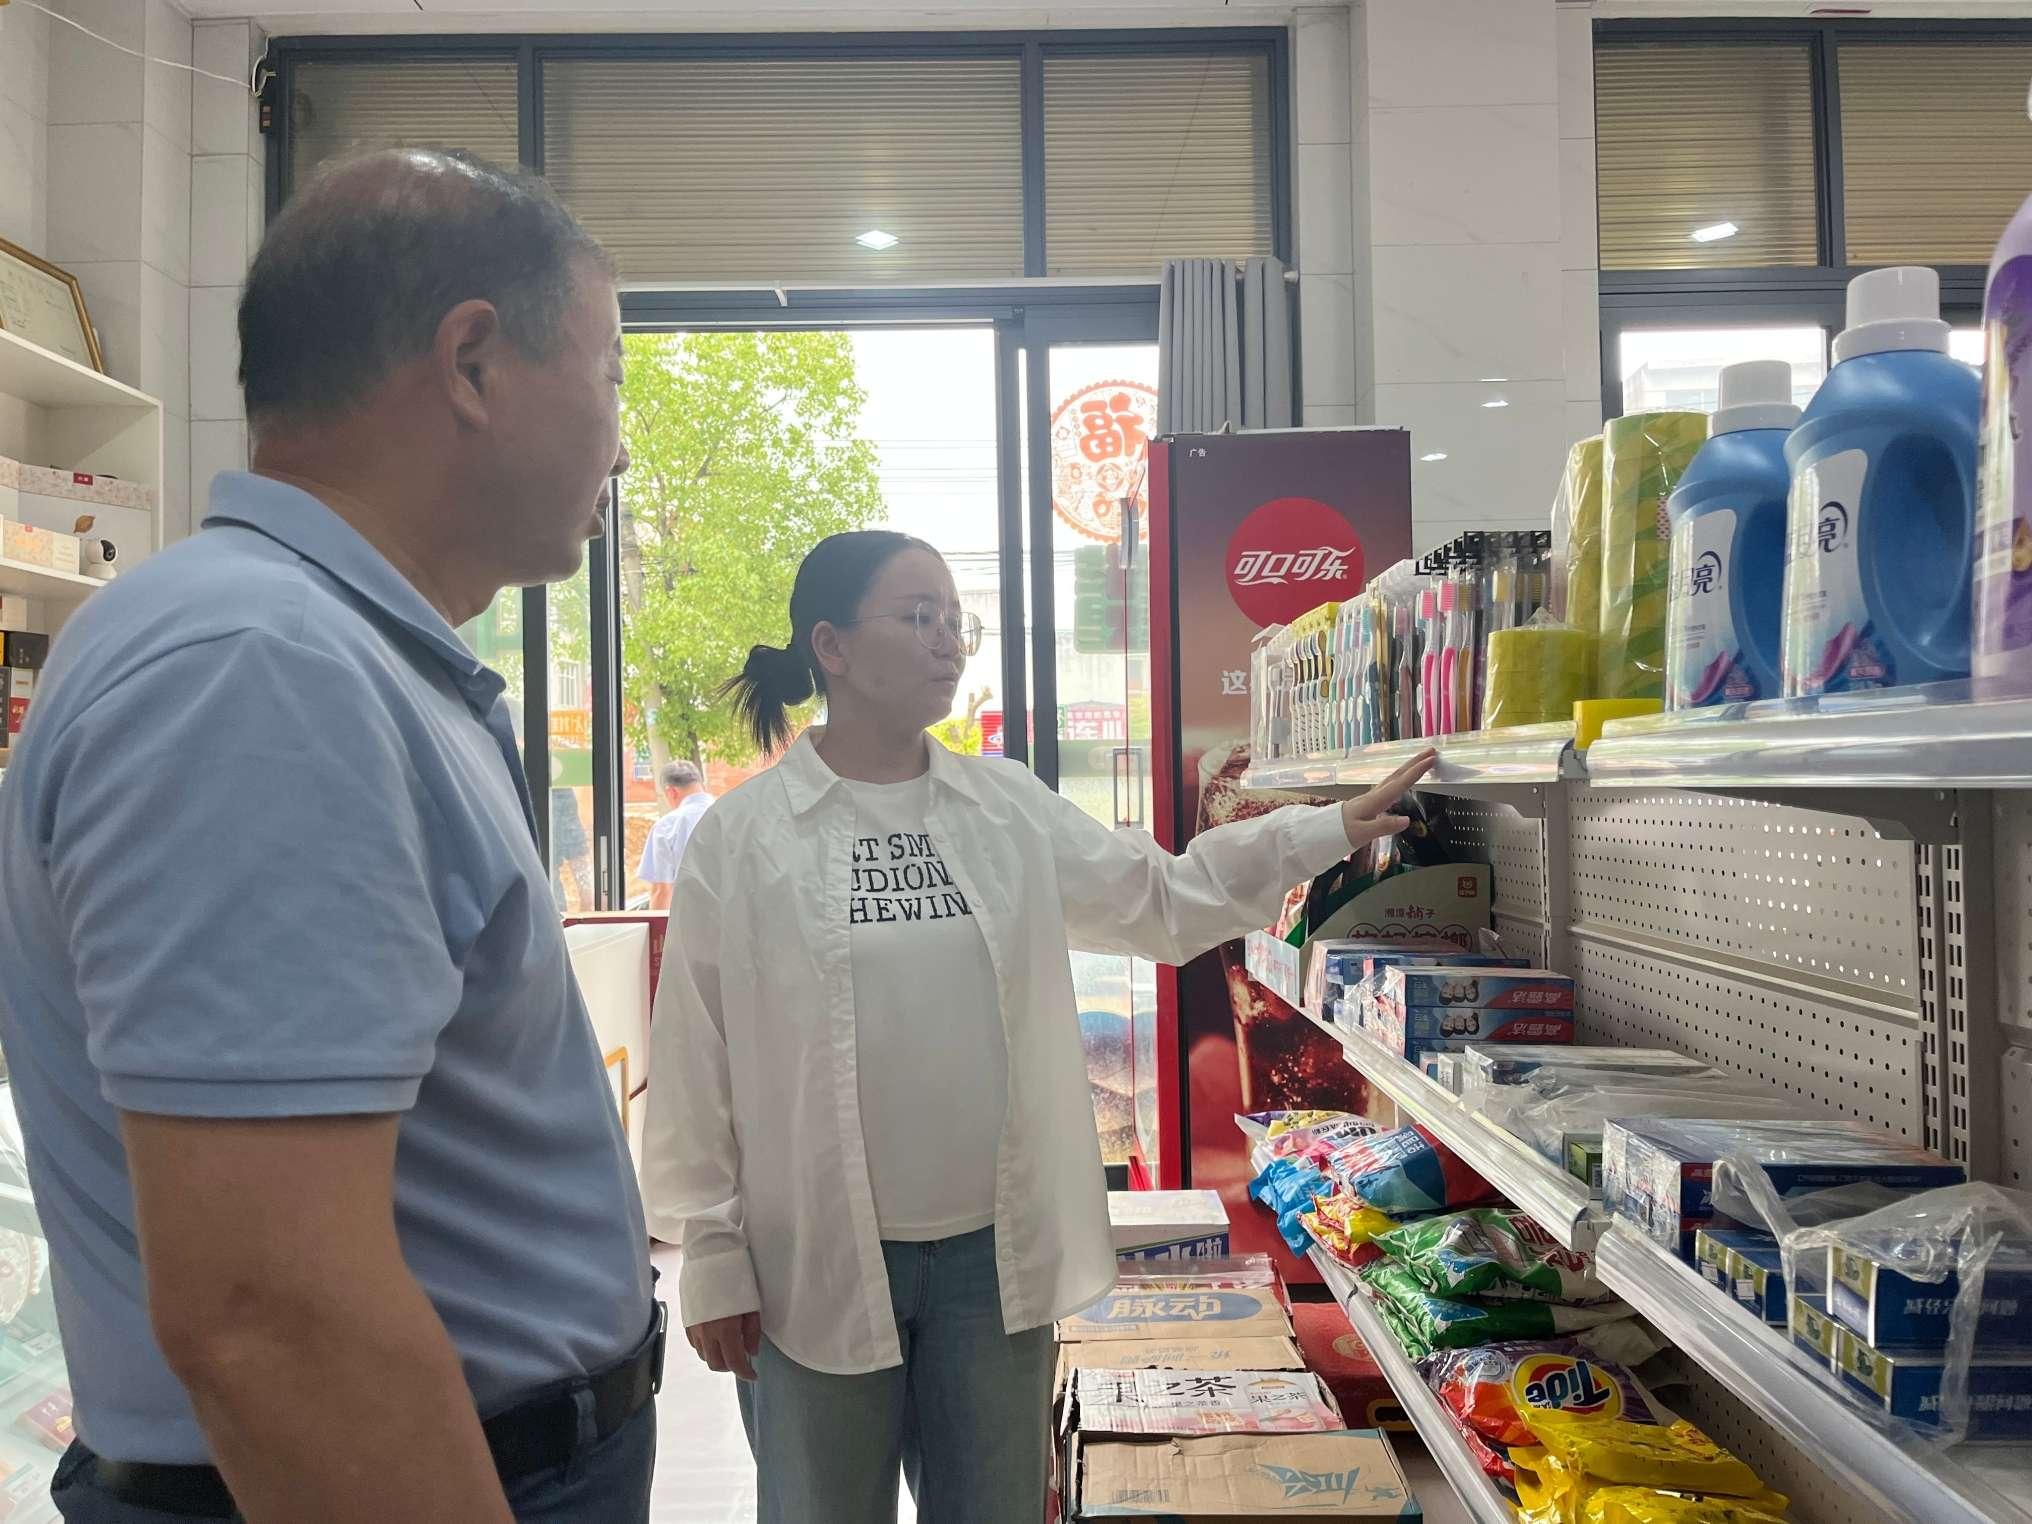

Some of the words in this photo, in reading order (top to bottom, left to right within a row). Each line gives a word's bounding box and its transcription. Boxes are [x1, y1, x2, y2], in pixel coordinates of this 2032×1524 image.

[1234, 546, 1356, 585] 可口可乐
[1221, 670, 1248, 695] 这
[1107, 1296, 1222, 1321] 脉动
[1524, 1359, 1611, 1410] Tide
